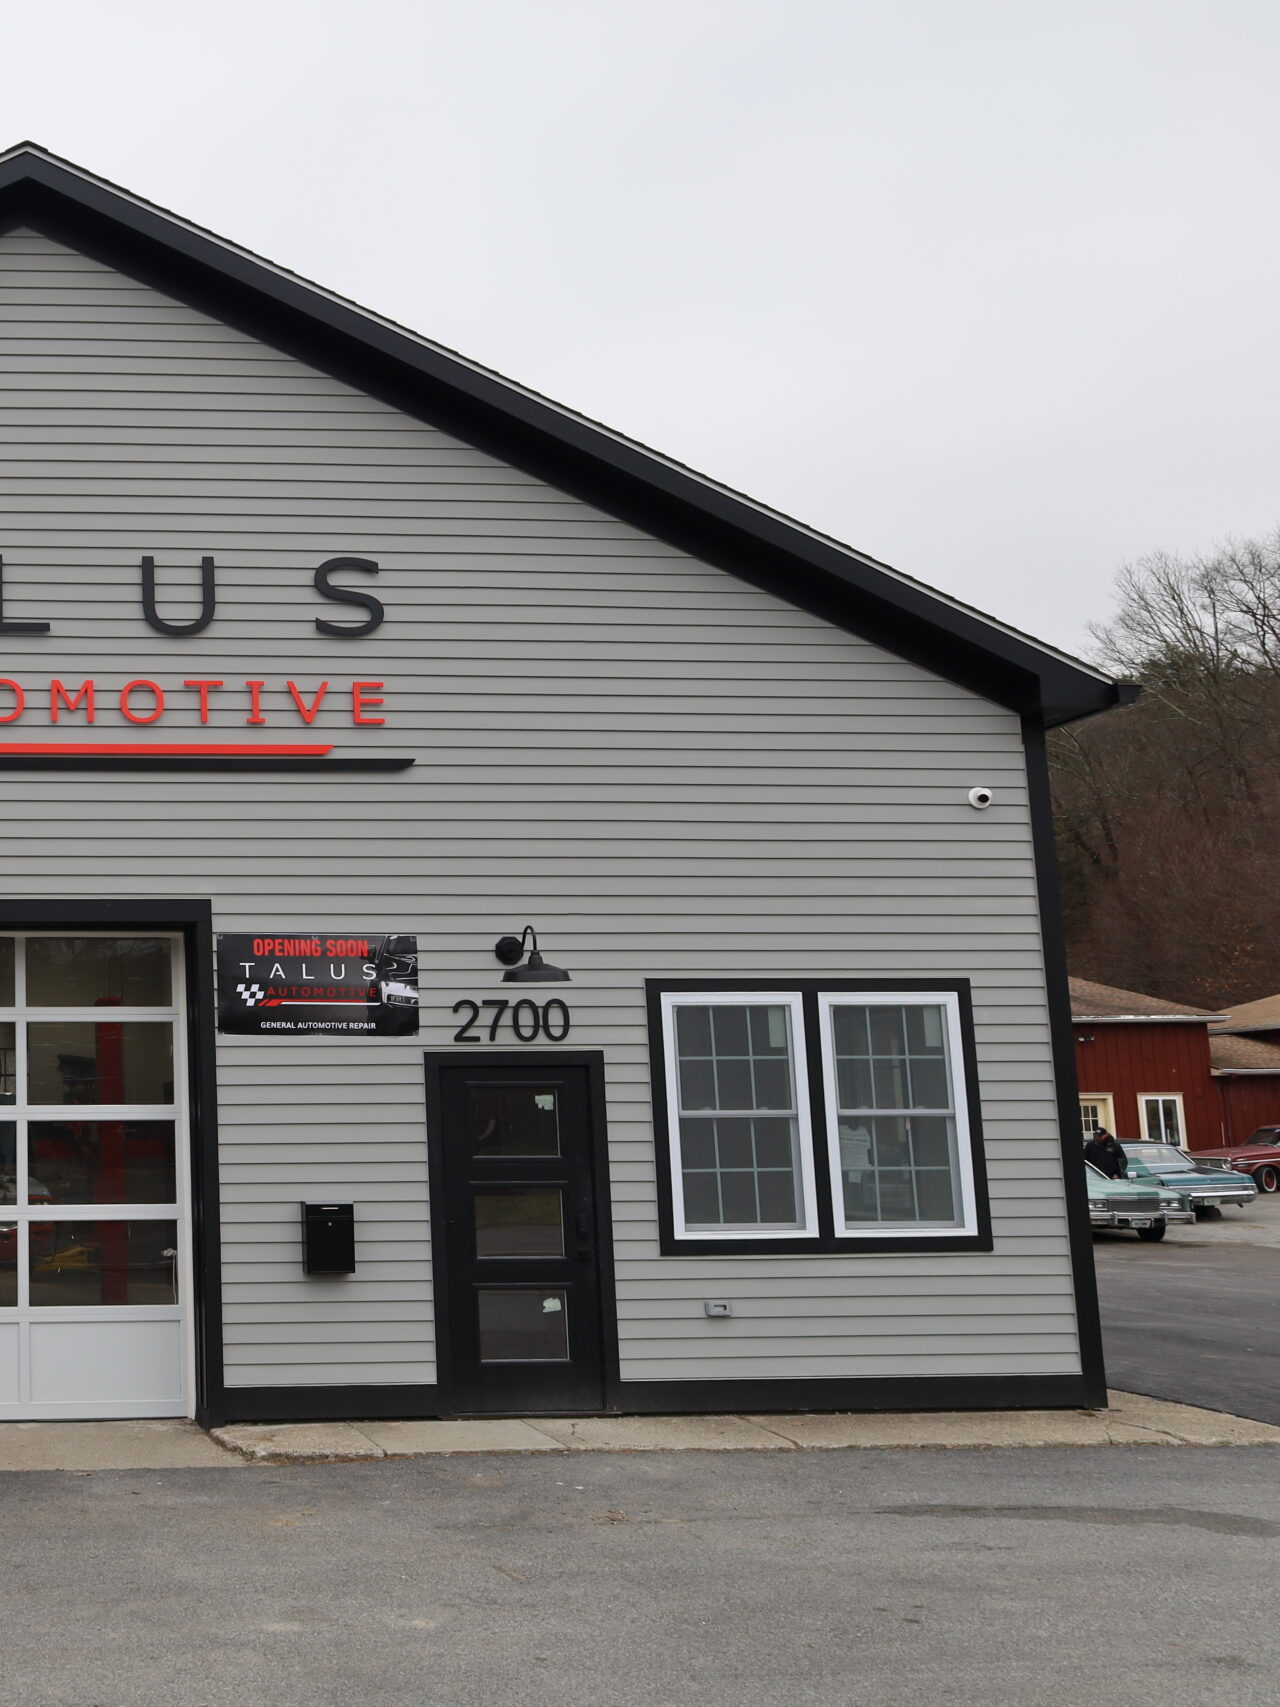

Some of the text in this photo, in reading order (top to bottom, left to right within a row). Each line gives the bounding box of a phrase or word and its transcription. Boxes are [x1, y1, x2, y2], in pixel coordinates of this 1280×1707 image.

[252, 938, 369, 957] OPENING SOON
[239, 962, 377, 980] TALUS
[266, 986, 377, 998] AUTOMOTIVE
[260, 1021, 377, 1030] GENERAL AUTOMOTIVE REPAIR
[452, 998, 570, 1042] 2700
